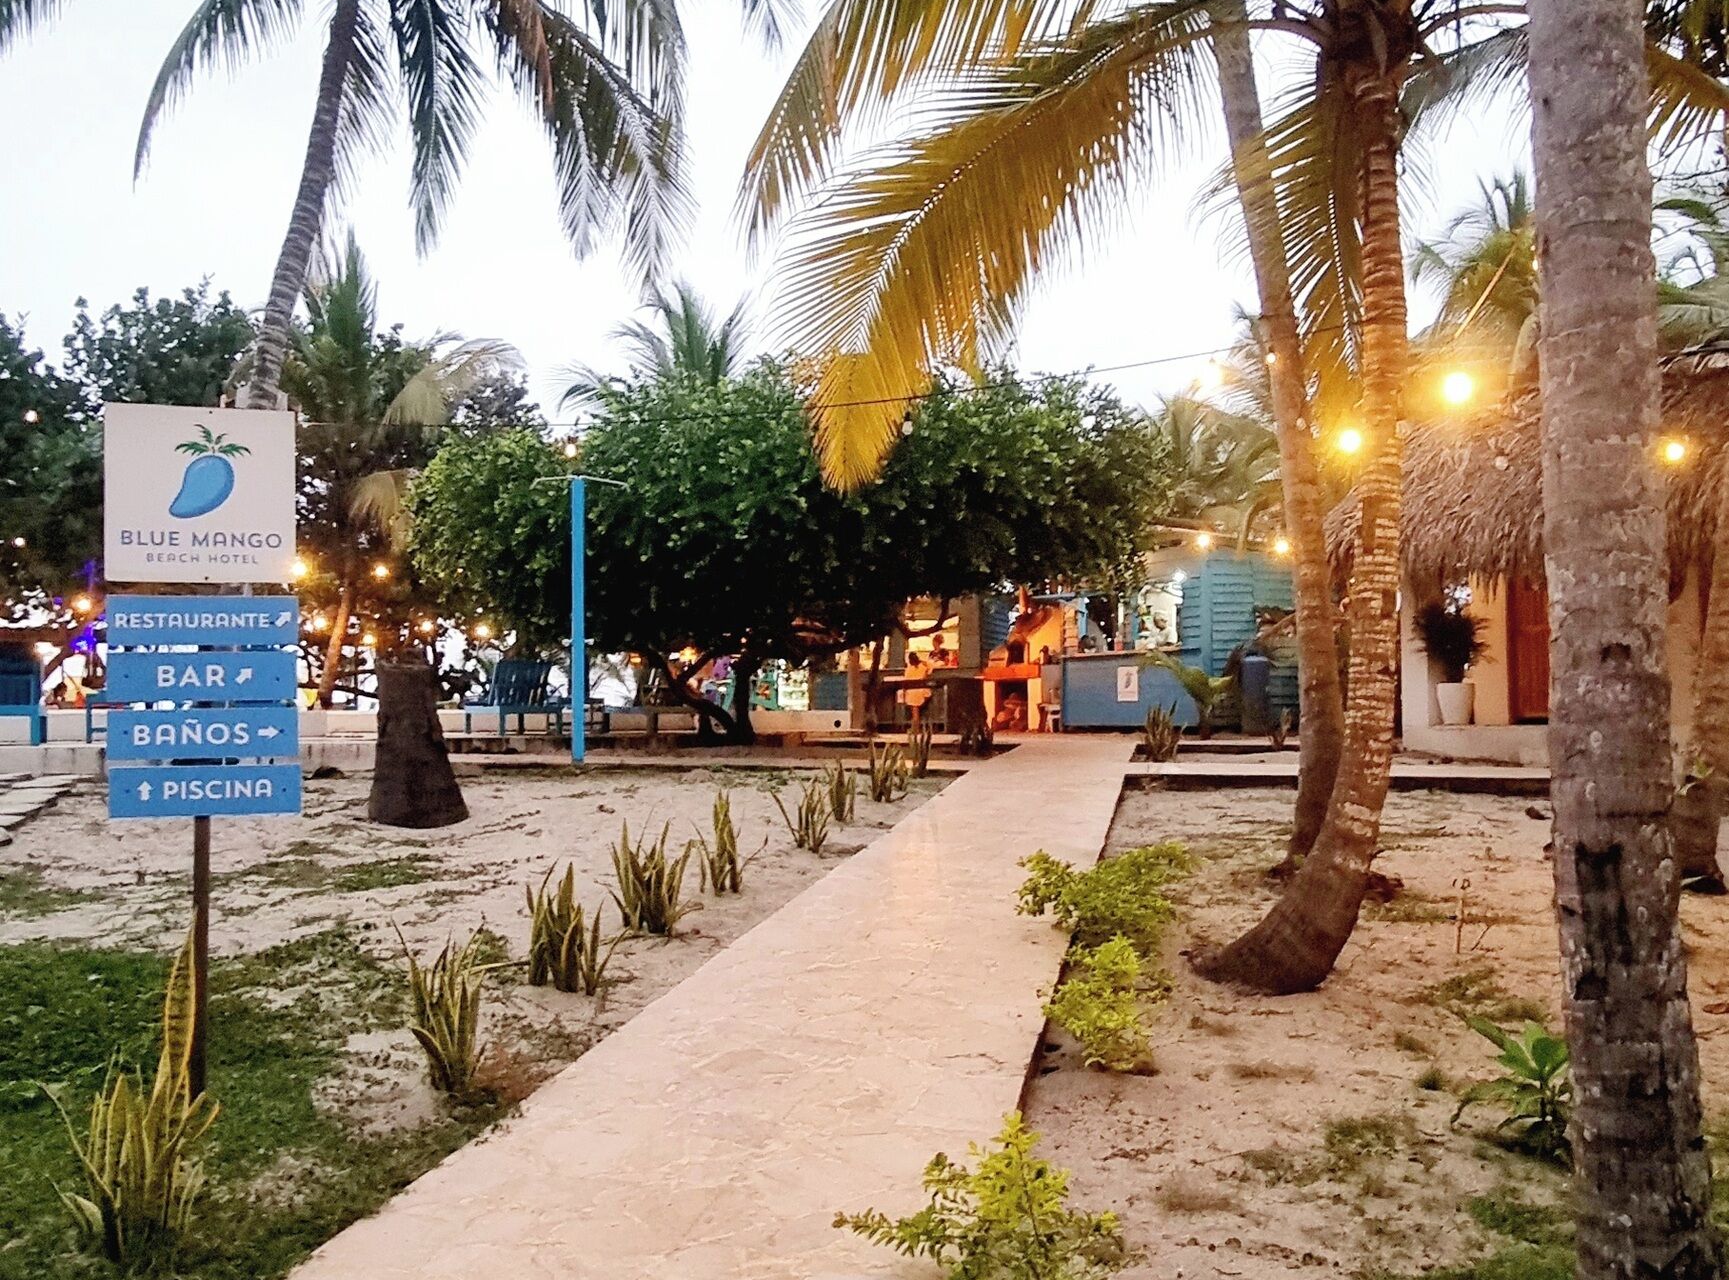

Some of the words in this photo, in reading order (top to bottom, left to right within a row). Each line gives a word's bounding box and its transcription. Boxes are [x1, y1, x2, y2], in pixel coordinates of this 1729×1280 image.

[120, 529, 180, 548] BLUE
[192, 531, 283, 549] MANGO
[146, 553, 200, 564] BEACH
[208, 553, 259, 565] HOTEL
[114, 612, 270, 629] RESTAURANTE
[157, 665, 226, 688] BAR
[132, 719, 250, 746] BAÑOS
[163, 779, 273, 800] PISCINA
